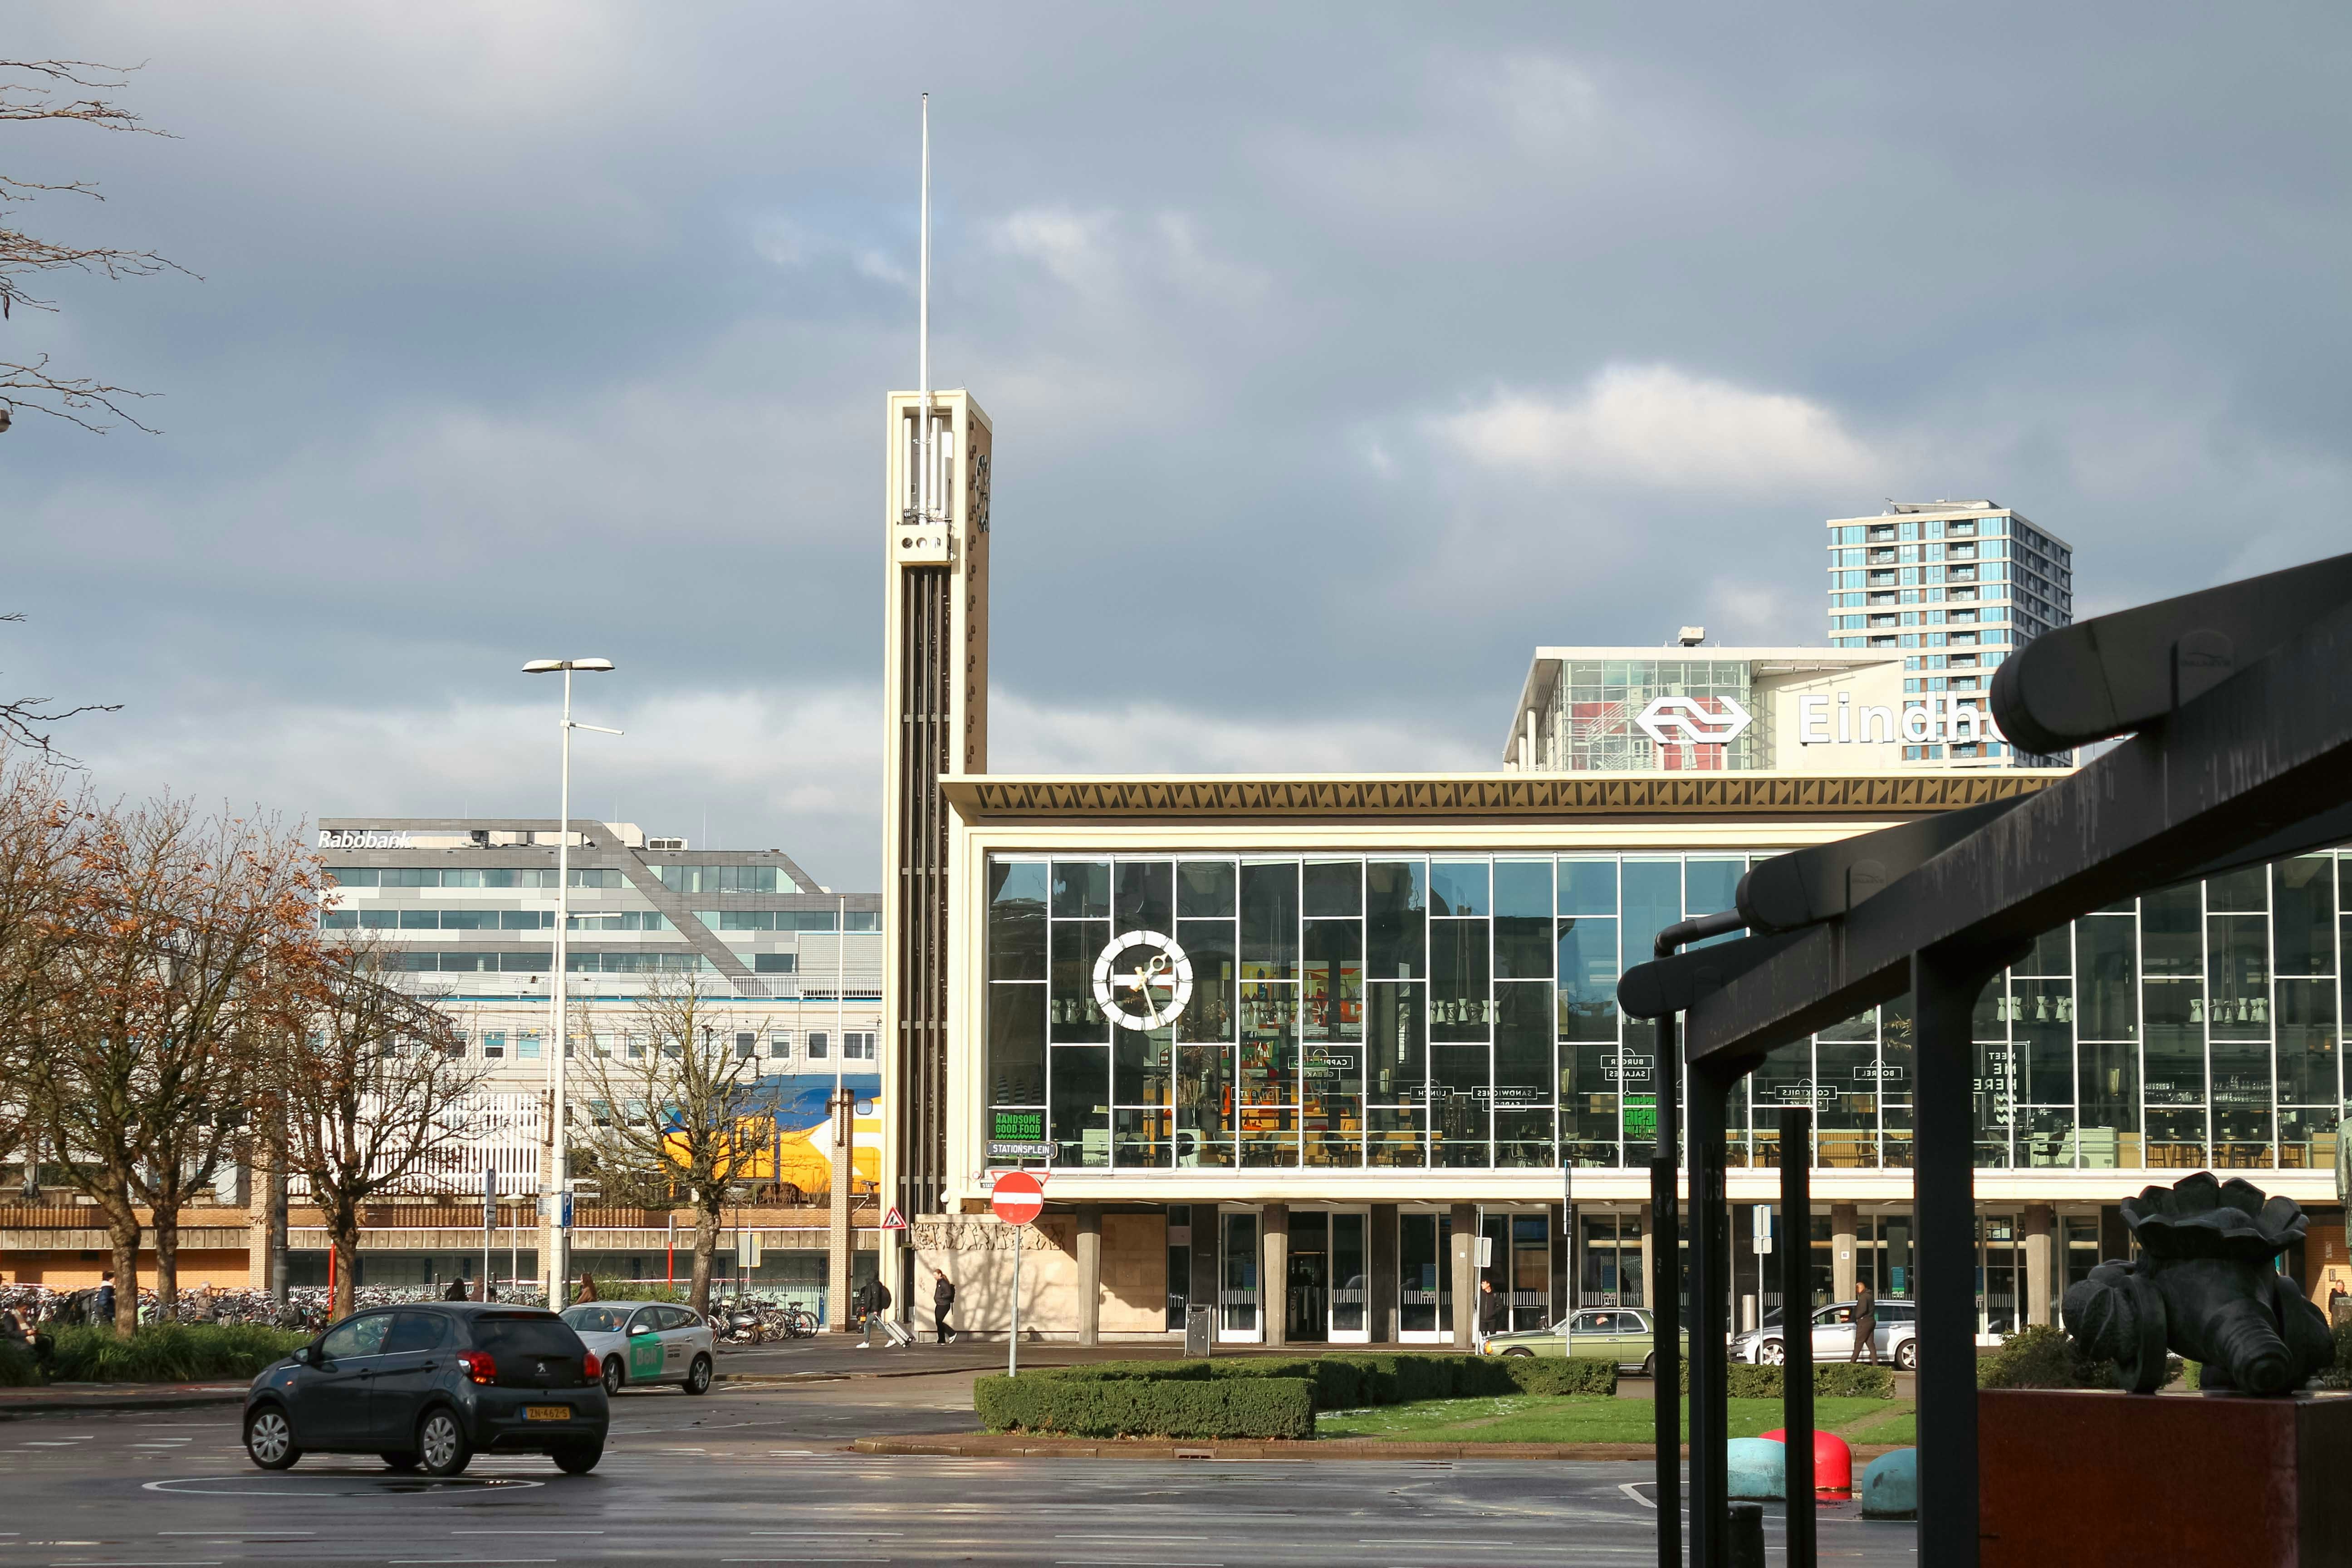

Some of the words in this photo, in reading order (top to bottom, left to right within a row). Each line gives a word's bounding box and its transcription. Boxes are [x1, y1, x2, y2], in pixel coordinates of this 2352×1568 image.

[1799, 691, 2008, 743] Eindh
[318, 830, 413, 849] Rabobank
[996, 1115, 1040, 1124] HANDSOME
[996, 1124, 1017, 1133] GOOD
[1020, 1124, 1040, 1133] FOOD
[993, 1144, 1049, 1154] STATIONSPLEIN
[490, 1171, 495, 1189] P
[564, 1195, 570, 1212] P
[637, 1348, 657, 1365] Bolt
